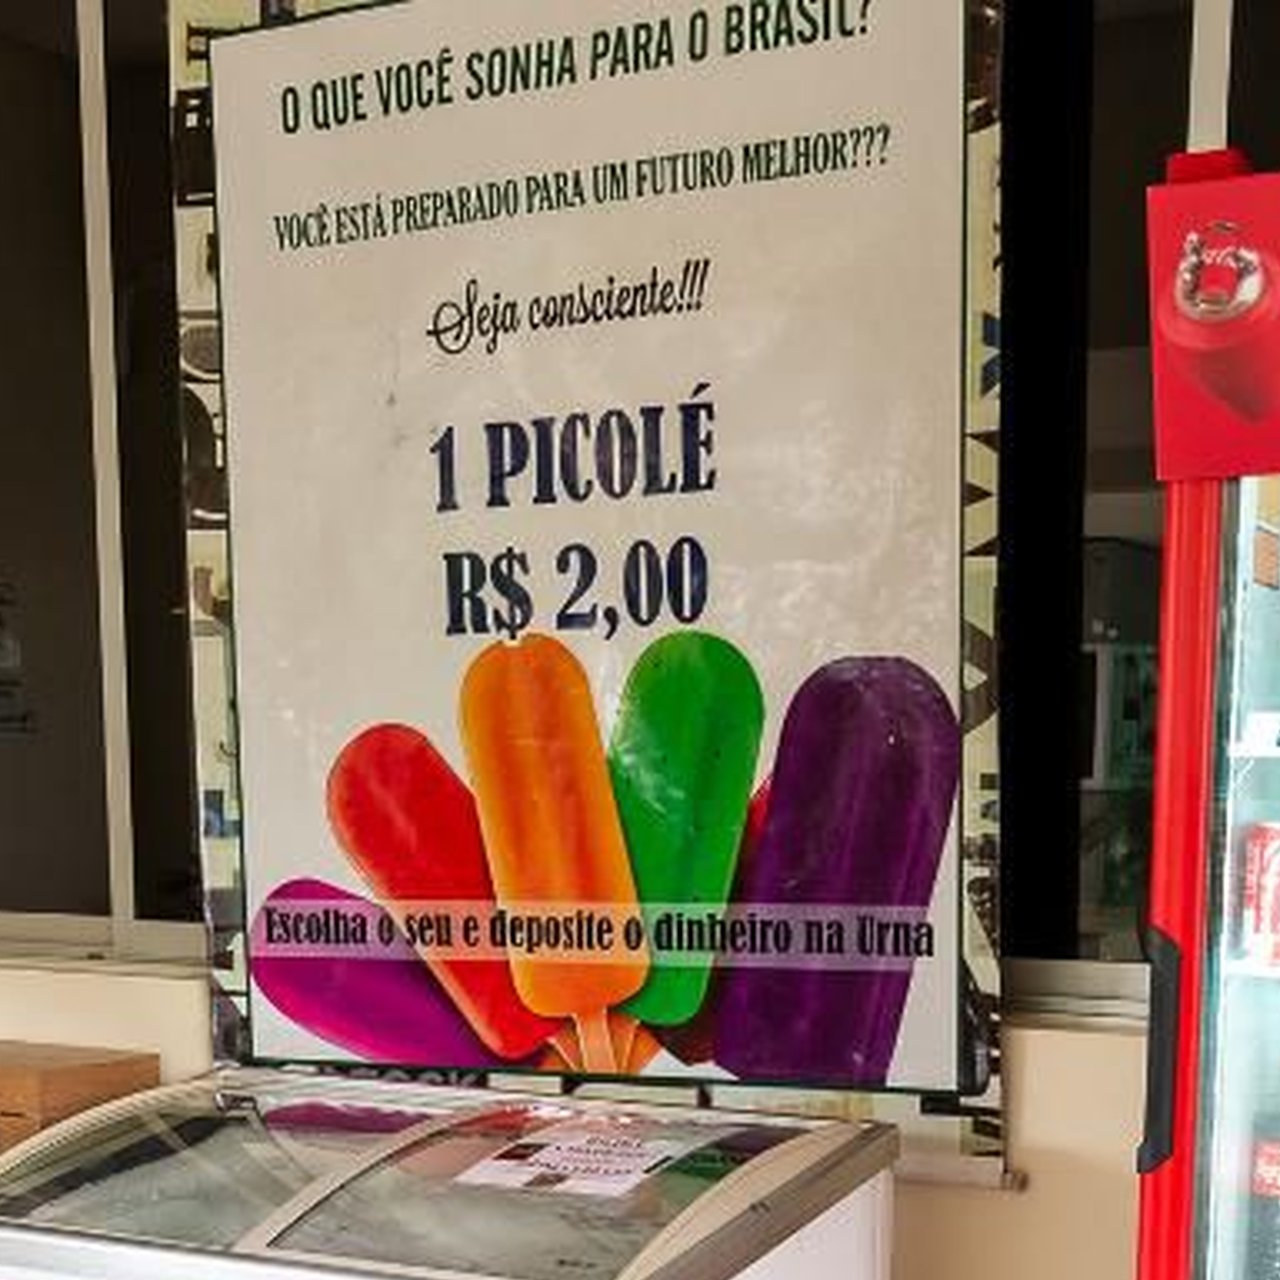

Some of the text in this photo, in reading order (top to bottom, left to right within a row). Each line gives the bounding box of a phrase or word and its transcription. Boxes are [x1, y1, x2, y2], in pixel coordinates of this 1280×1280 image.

[282, 0, 871, 134] O QUE VOCÊ SONHA PARA O BRASIL?
[273, 123, 892, 251] VOCÊ ESTÁ PREPARADO PARA UM FUTURO MELHOR???
[426, 258, 712, 354] Seja consciente!!!
[429, 383, 718, 513] 1 PICOLÉ
[443, 534, 710, 641] R$ 2,00
[264, 906, 935, 957] Escolha o seu e deposite o dinheiro na Urna
